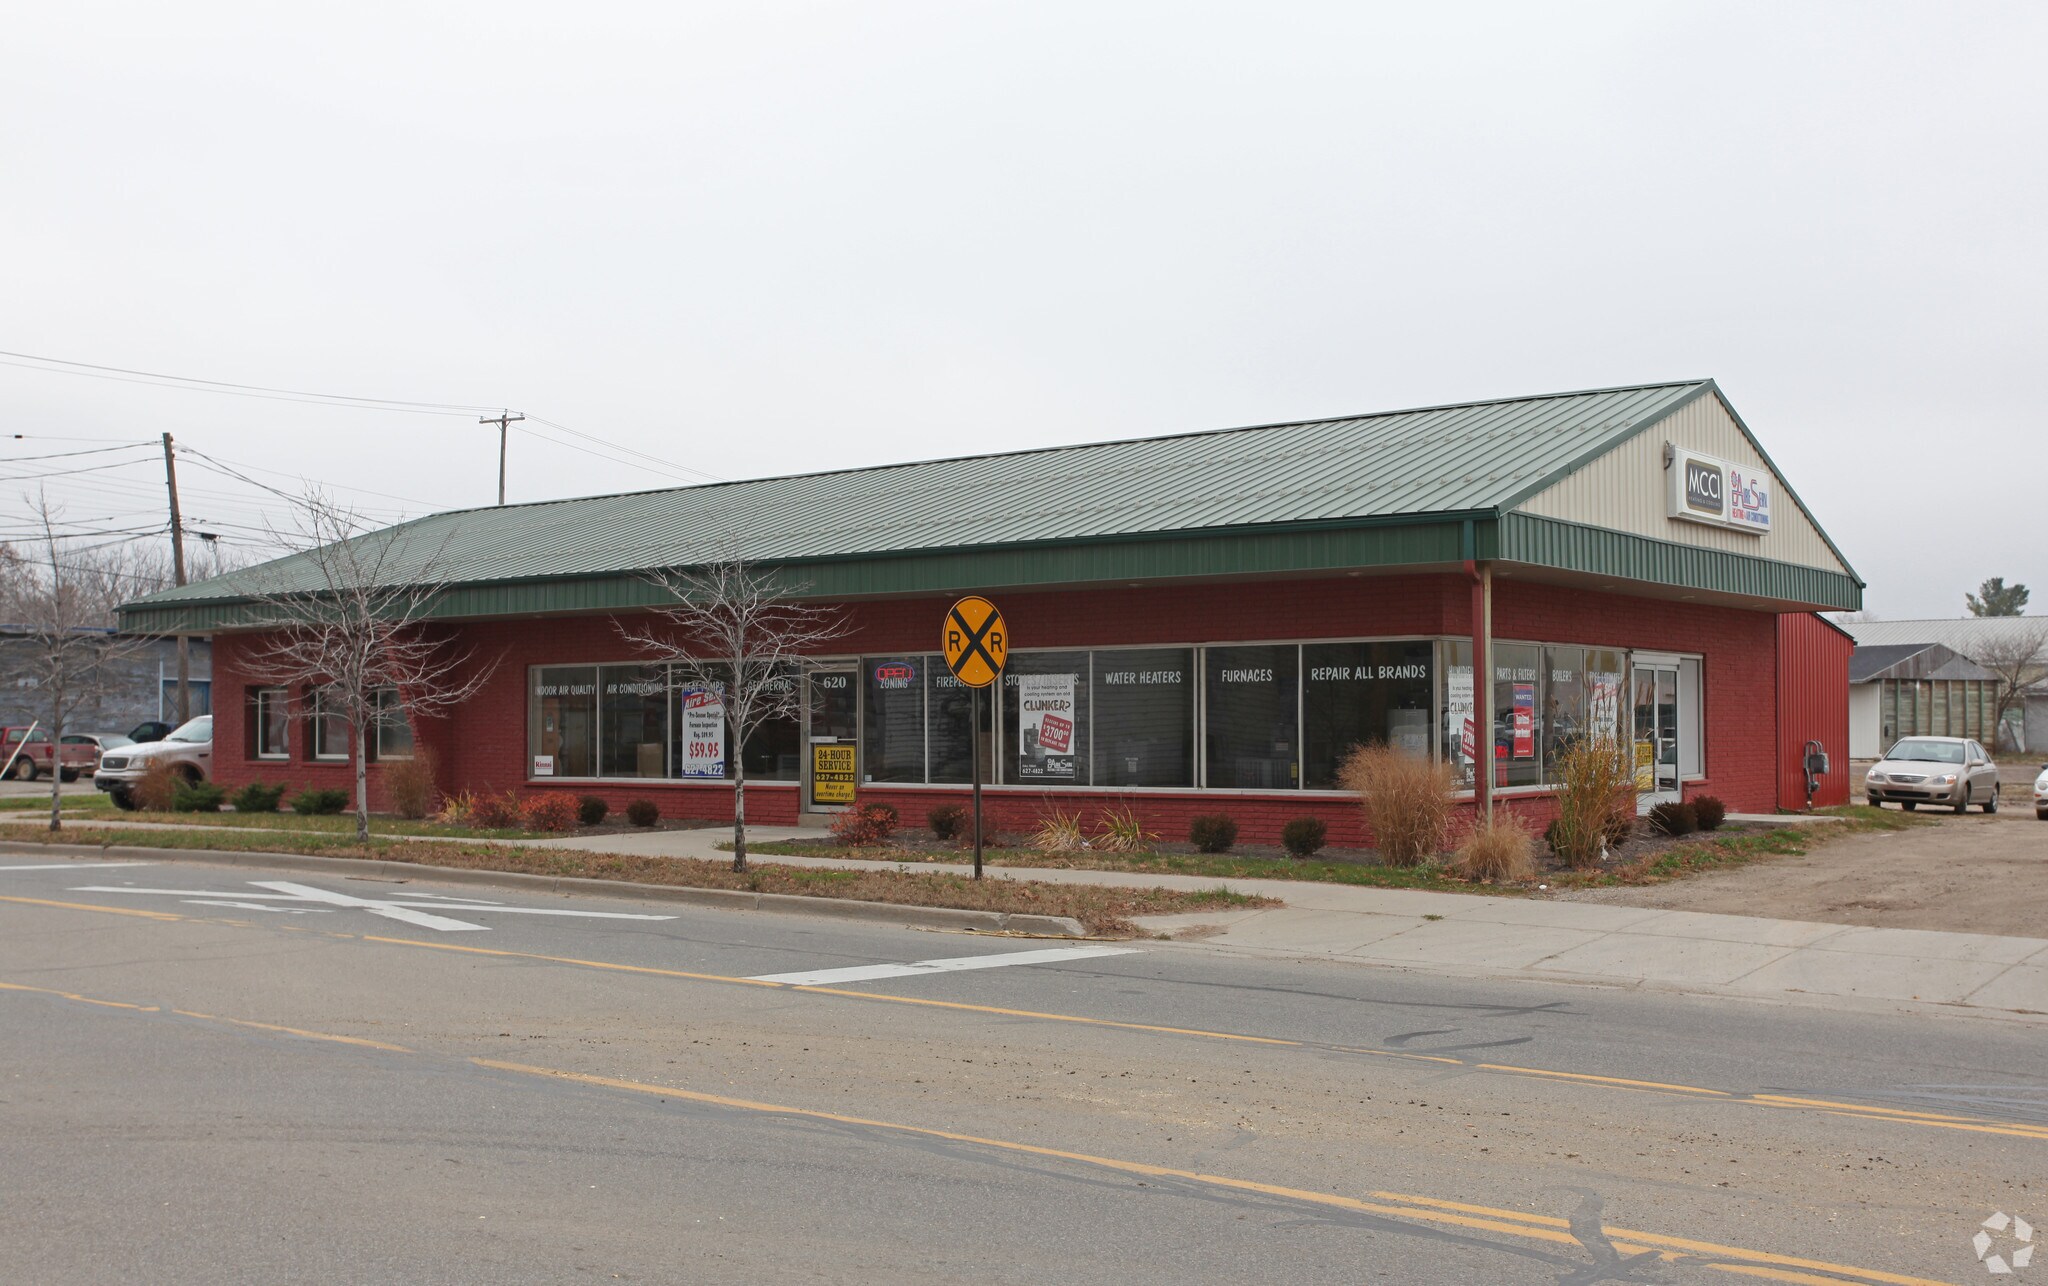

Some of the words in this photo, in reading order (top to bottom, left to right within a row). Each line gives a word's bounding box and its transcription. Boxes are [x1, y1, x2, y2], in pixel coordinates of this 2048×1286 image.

[1688, 467, 1720, 500] MCCI
[948, 631, 961, 652] R
[990, 632, 1003, 653] R
[877, 668, 912, 681] OPEN
[1105, 672, 1136, 685] WATER
[1139, 671, 1182, 684] HEATERS
[1221, 669, 1273, 682] FURNACES
[1311, 667, 1350, 680] REPAIR
[1354, 666, 1374, 680] ALL
[1378, 665, 1426, 679] BRANDS
[1496, 667, 1511, 680] PARTS
[1513, 669, 1516, 680] &
[1518, 669, 1536, 681] FILTERS
[1552, 670, 1572, 682] BOILERS
[607, 684, 618, 694] AIR
[620, 683, 664, 694] CONDITIONING
[823, 677, 847, 689] 620
[880, 677, 908, 689] ZONING
[535, 686, 557, 696] INDOOR
[558, 686, 569, 695] AIR
[571, 684, 596, 696] QUALITY
[1023, 699, 1071, 713] CLUNKER?
[689, 741, 719, 759] $59.95
[818, 749, 852, 760] 24-HOUR
[685, 764, 723, 775] 627-4822
[818, 760, 852, 771] SERVICE
[836, 790, 854, 800] charge!
